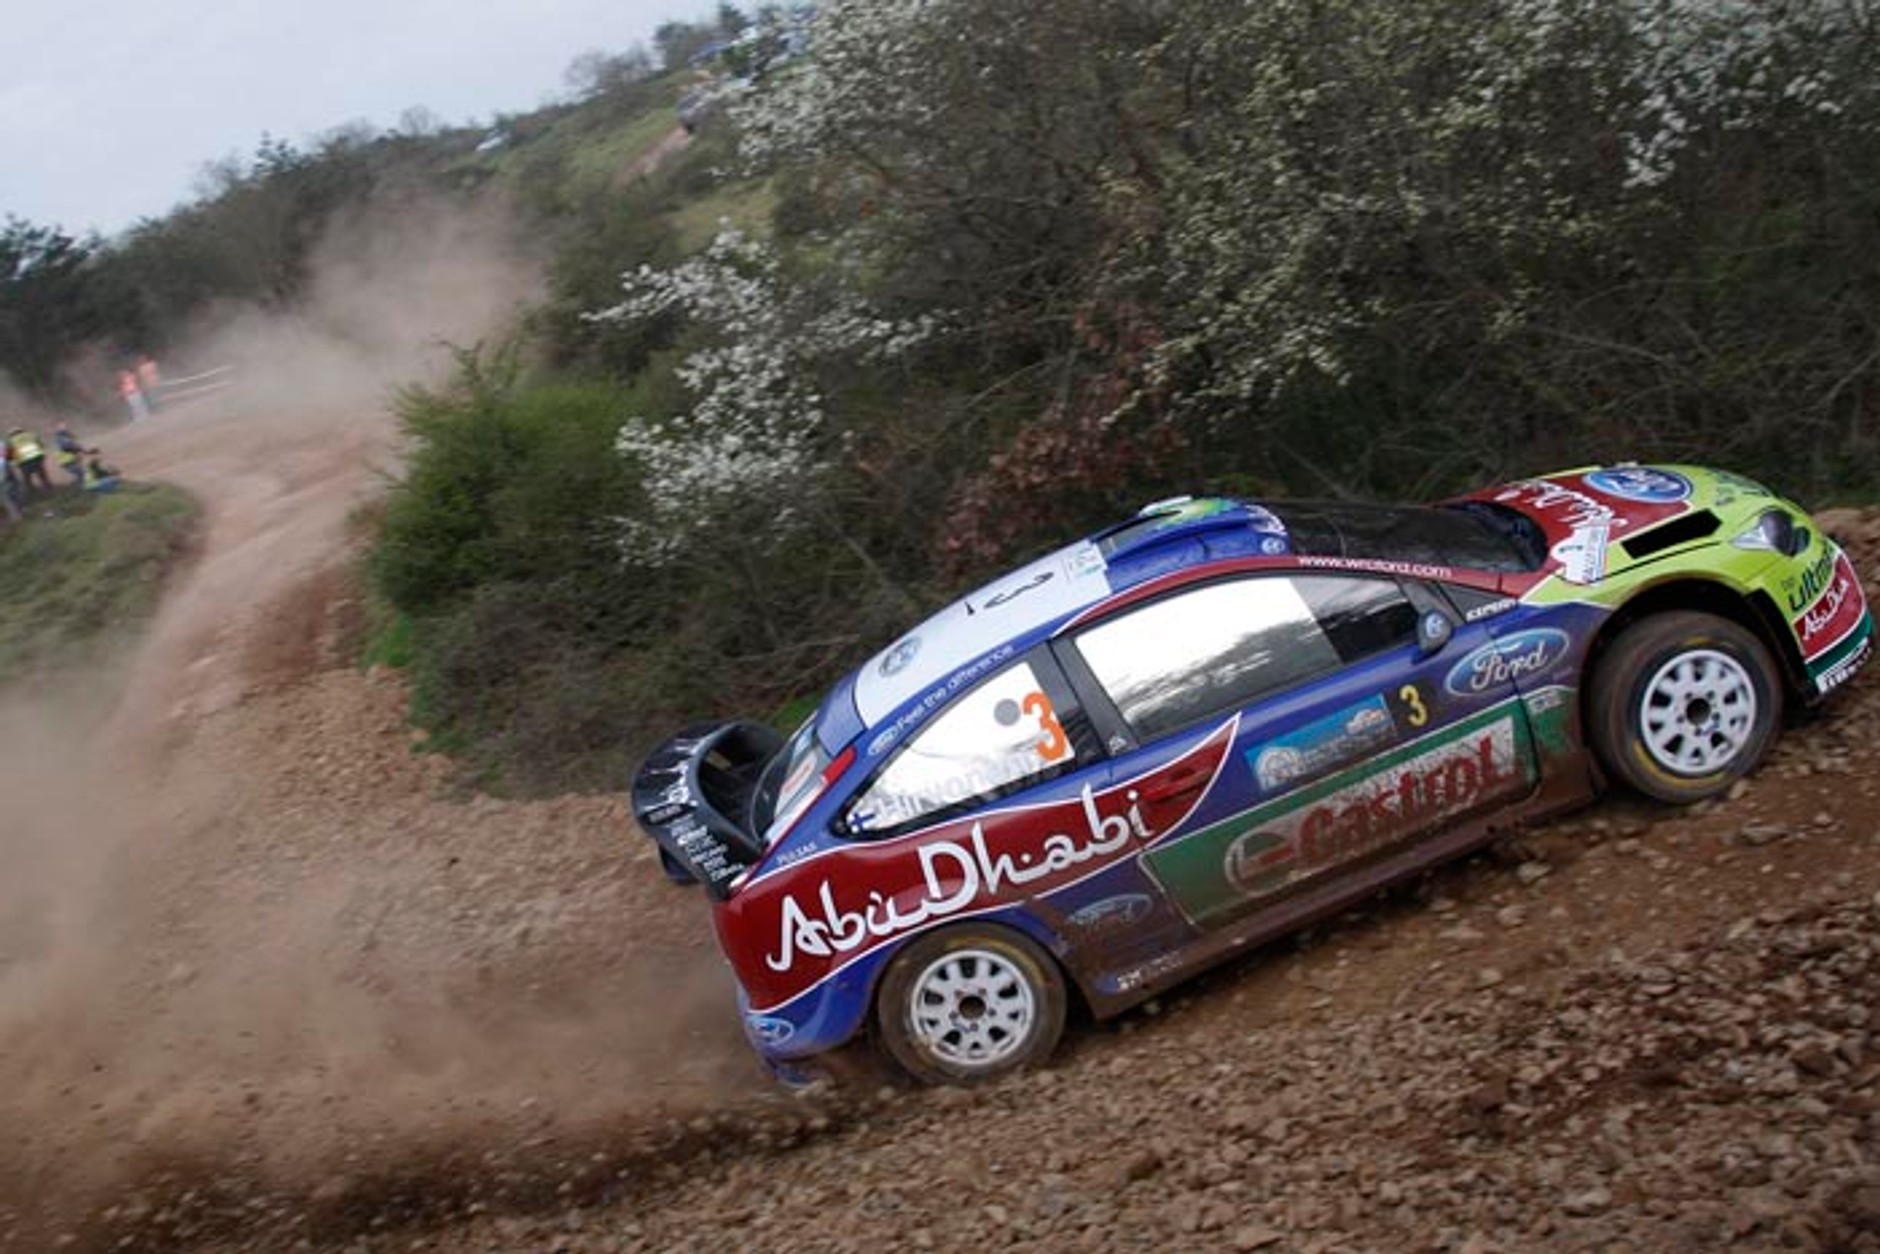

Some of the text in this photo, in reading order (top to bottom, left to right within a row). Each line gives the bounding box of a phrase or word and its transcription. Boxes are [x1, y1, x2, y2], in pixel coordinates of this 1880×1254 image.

[1468, 641, 1550, 691] Ford
[1022, 691, 1067, 763] 3
[1400, 684, 1429, 727] 3
[1299, 734, 1496, 866] Castrol
